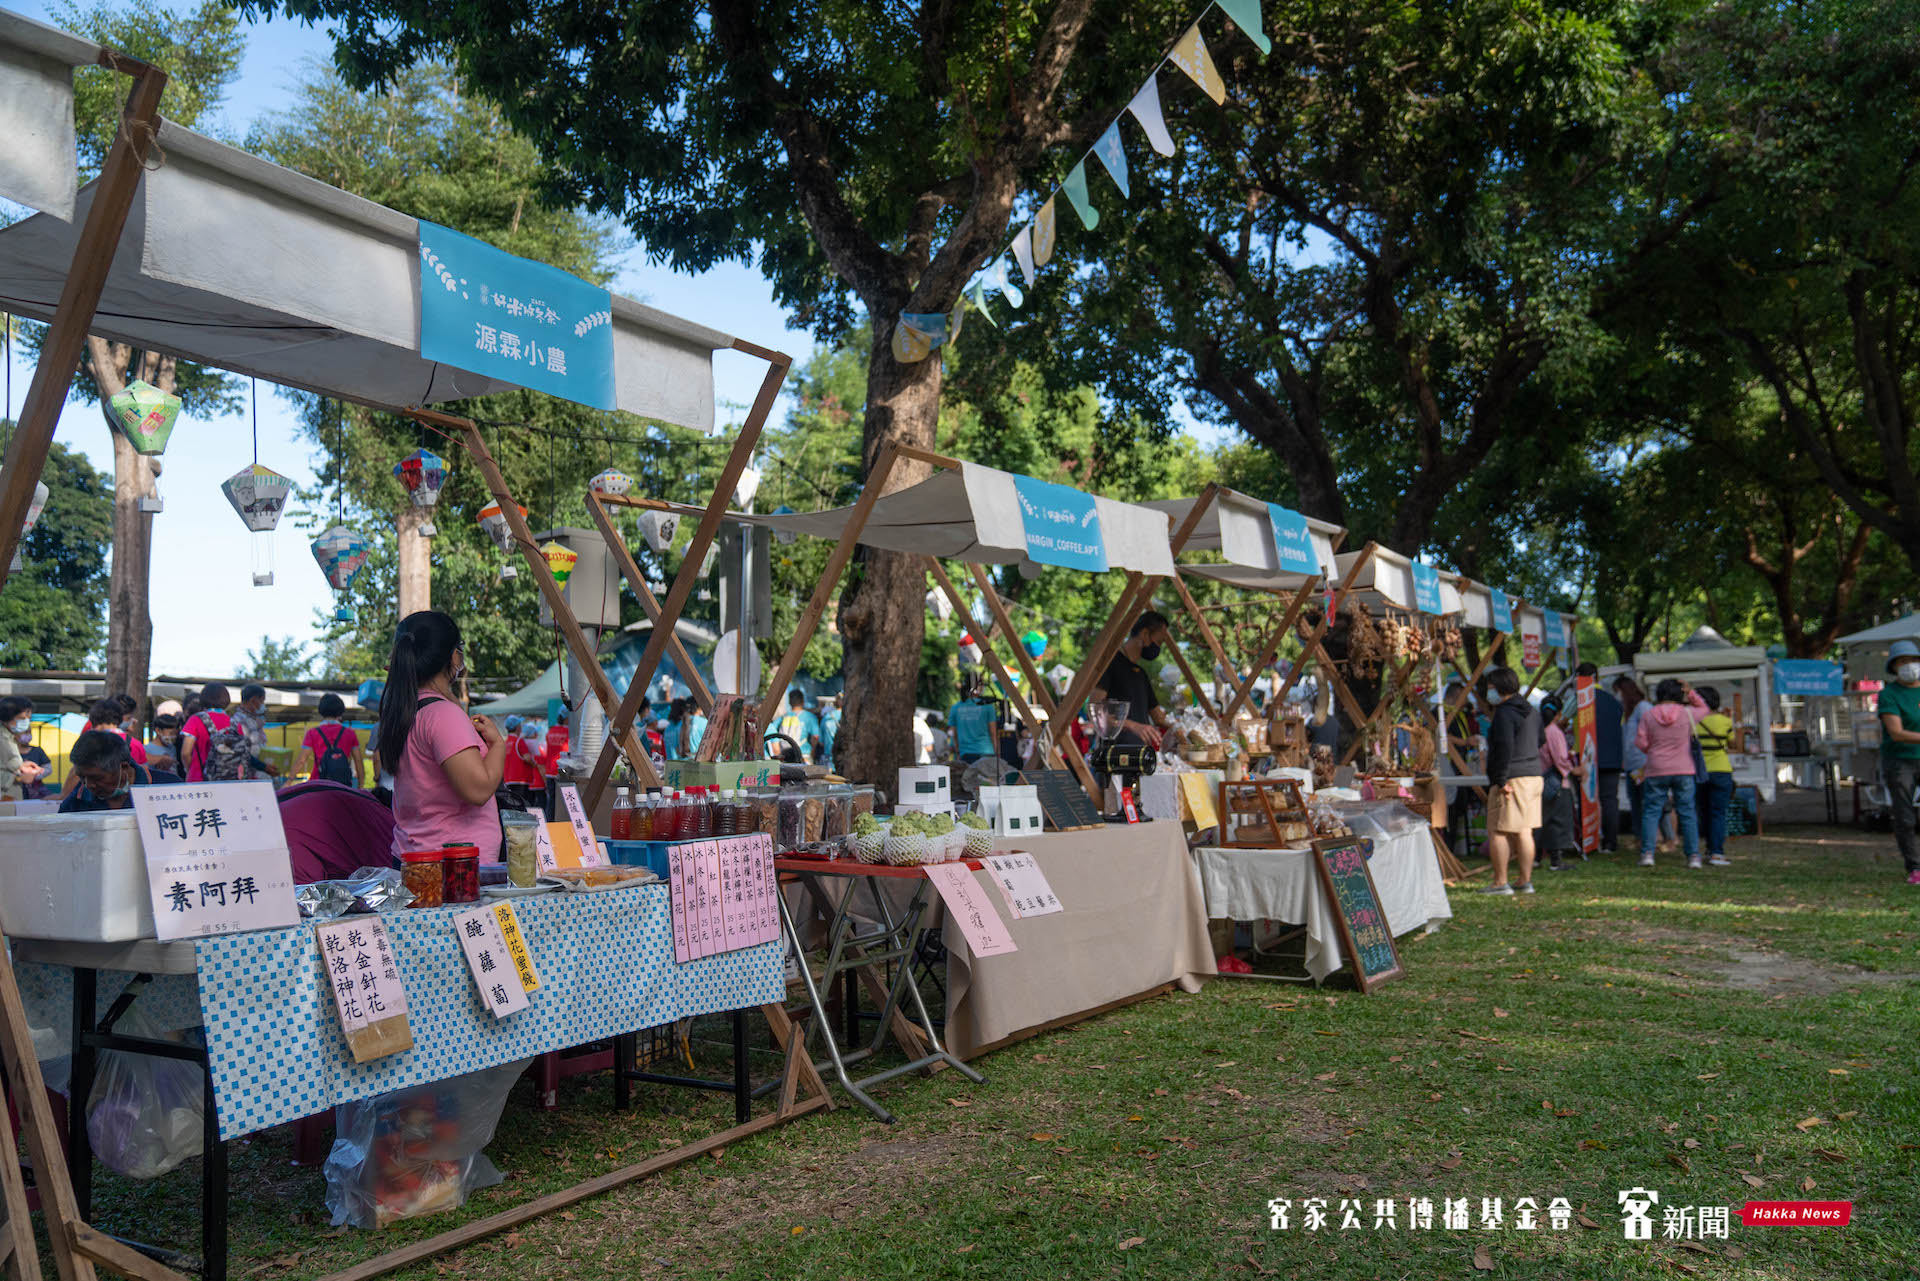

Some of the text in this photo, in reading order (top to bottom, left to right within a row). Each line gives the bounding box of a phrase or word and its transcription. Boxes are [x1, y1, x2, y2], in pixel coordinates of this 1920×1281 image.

[490, 292, 561, 325] 好米收冬祭
[474, 321, 567, 376] 源霖小農
[156, 808, 227, 840] 阿拜
[202, 848, 215, 857] 50
[586, 855, 595, 863] 30
[695, 847, 706, 909] 冰冬瓜茶
[707, 846, 718, 907] 冰紅茶
[721, 844, 732, 904] 冰紅龍果汁
[731, 843, 743, 903] 冰冬瓜檸檬
[742, 842, 753, 901] 冰檸檬紅茶
[763, 839, 775, 896] 冰洛神花茶
[164, 876, 260, 912] 素阿拜
[215, 922, 228, 932] 55
[372, 924, 398, 981] 無毒無硫
[325, 934, 363, 1021] 乾洛神花
[347, 929, 386, 1014] 乾金針花
[464, 918, 509, 1007] 醃蘿蔔
